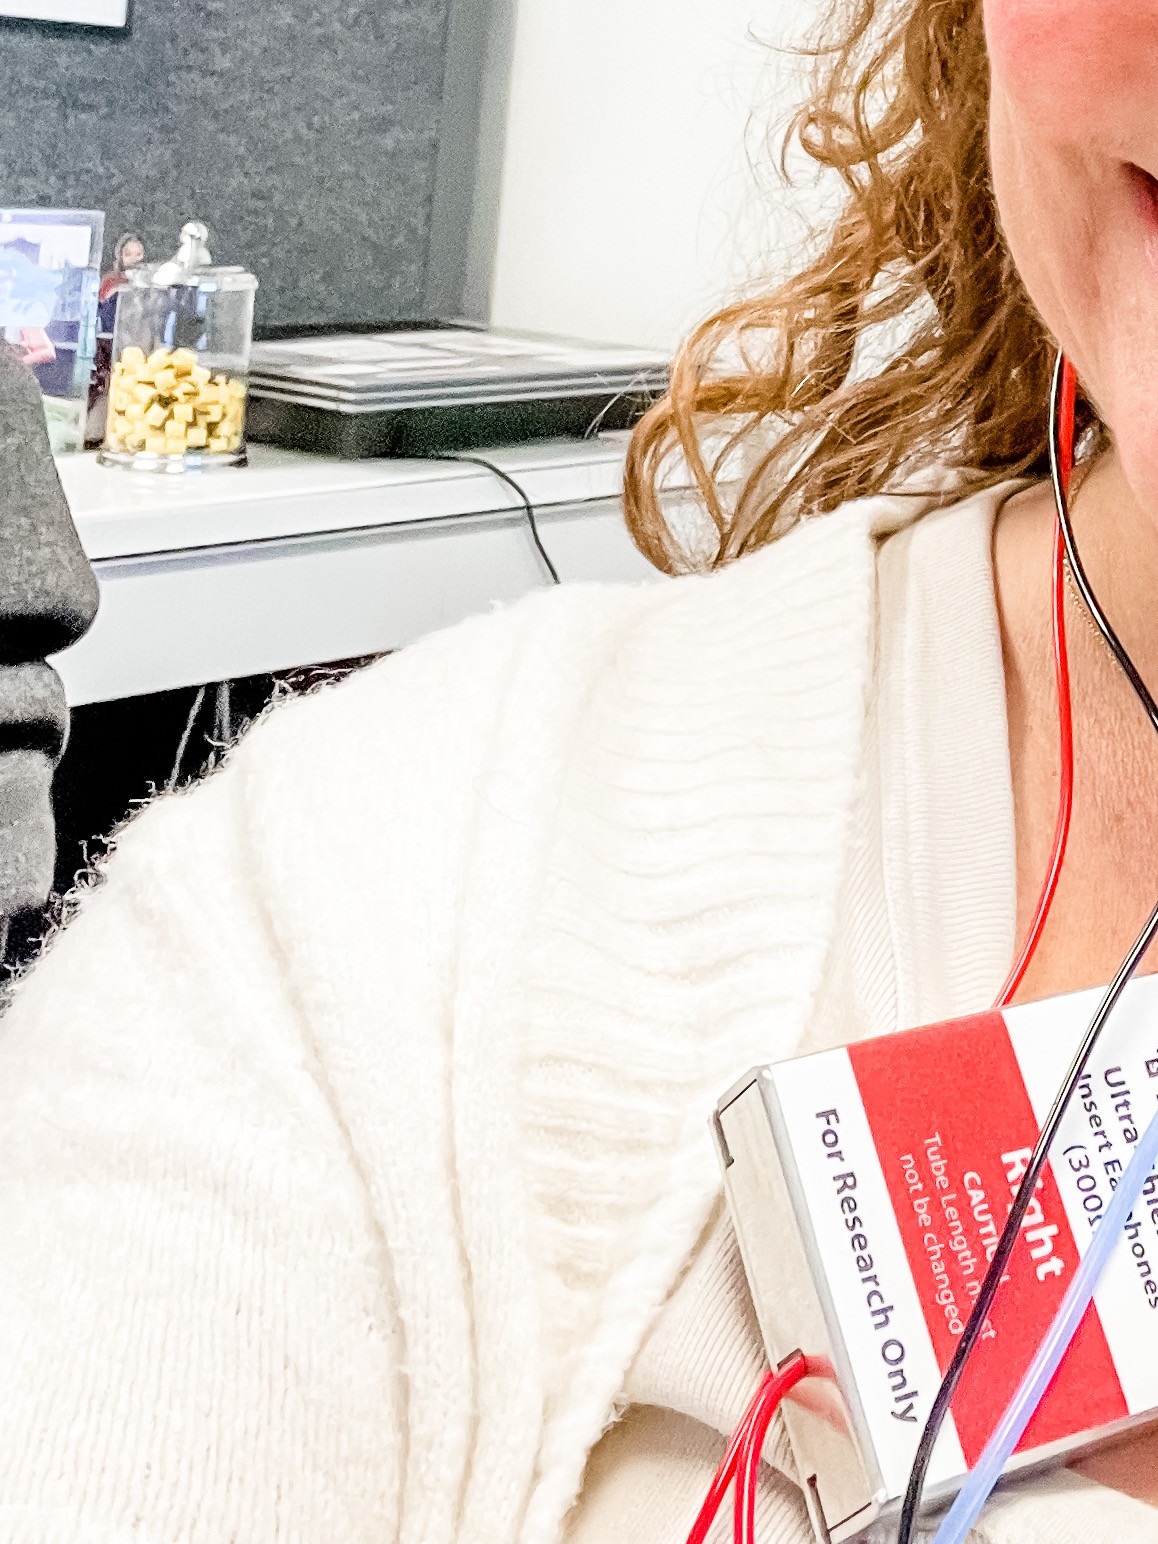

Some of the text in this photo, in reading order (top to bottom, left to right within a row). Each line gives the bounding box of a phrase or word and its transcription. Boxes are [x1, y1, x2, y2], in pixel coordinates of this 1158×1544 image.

[1077, 1073, 1113, 1153] Insert
[899, 1154, 965, 1335] not be changed
[924, 1131, 997, 1340] Tube Length mst
[963, 1171, 1010, 1283] CAUTI
[1062, 1144, 1105, 1233] (300
[815, 1108, 919, 1423] For Research Only
